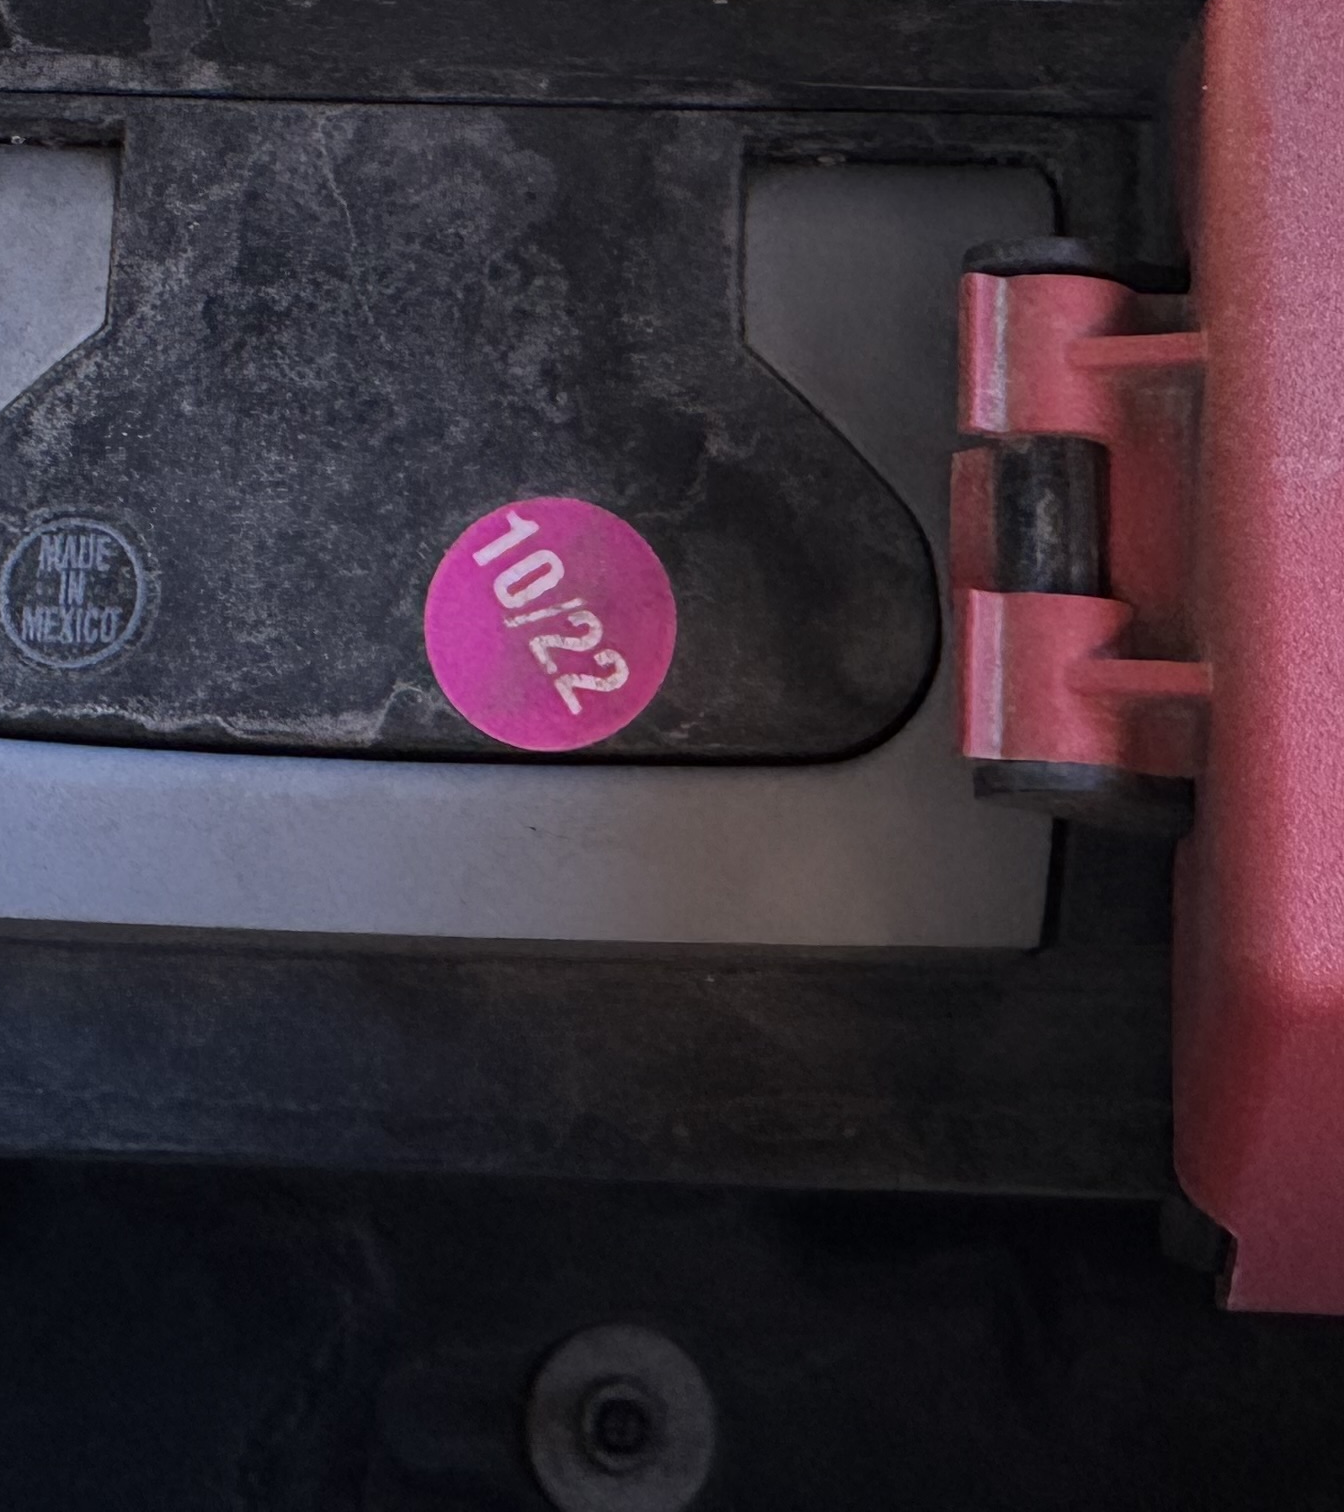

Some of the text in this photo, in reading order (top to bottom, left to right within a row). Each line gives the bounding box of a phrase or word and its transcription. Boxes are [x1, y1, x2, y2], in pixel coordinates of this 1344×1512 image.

[37, 532, 113, 572] MADE
[59, 569, 87, 606] IN
[21, 605, 124, 644] MEXICO
[471, 509, 630, 716] 10/22
